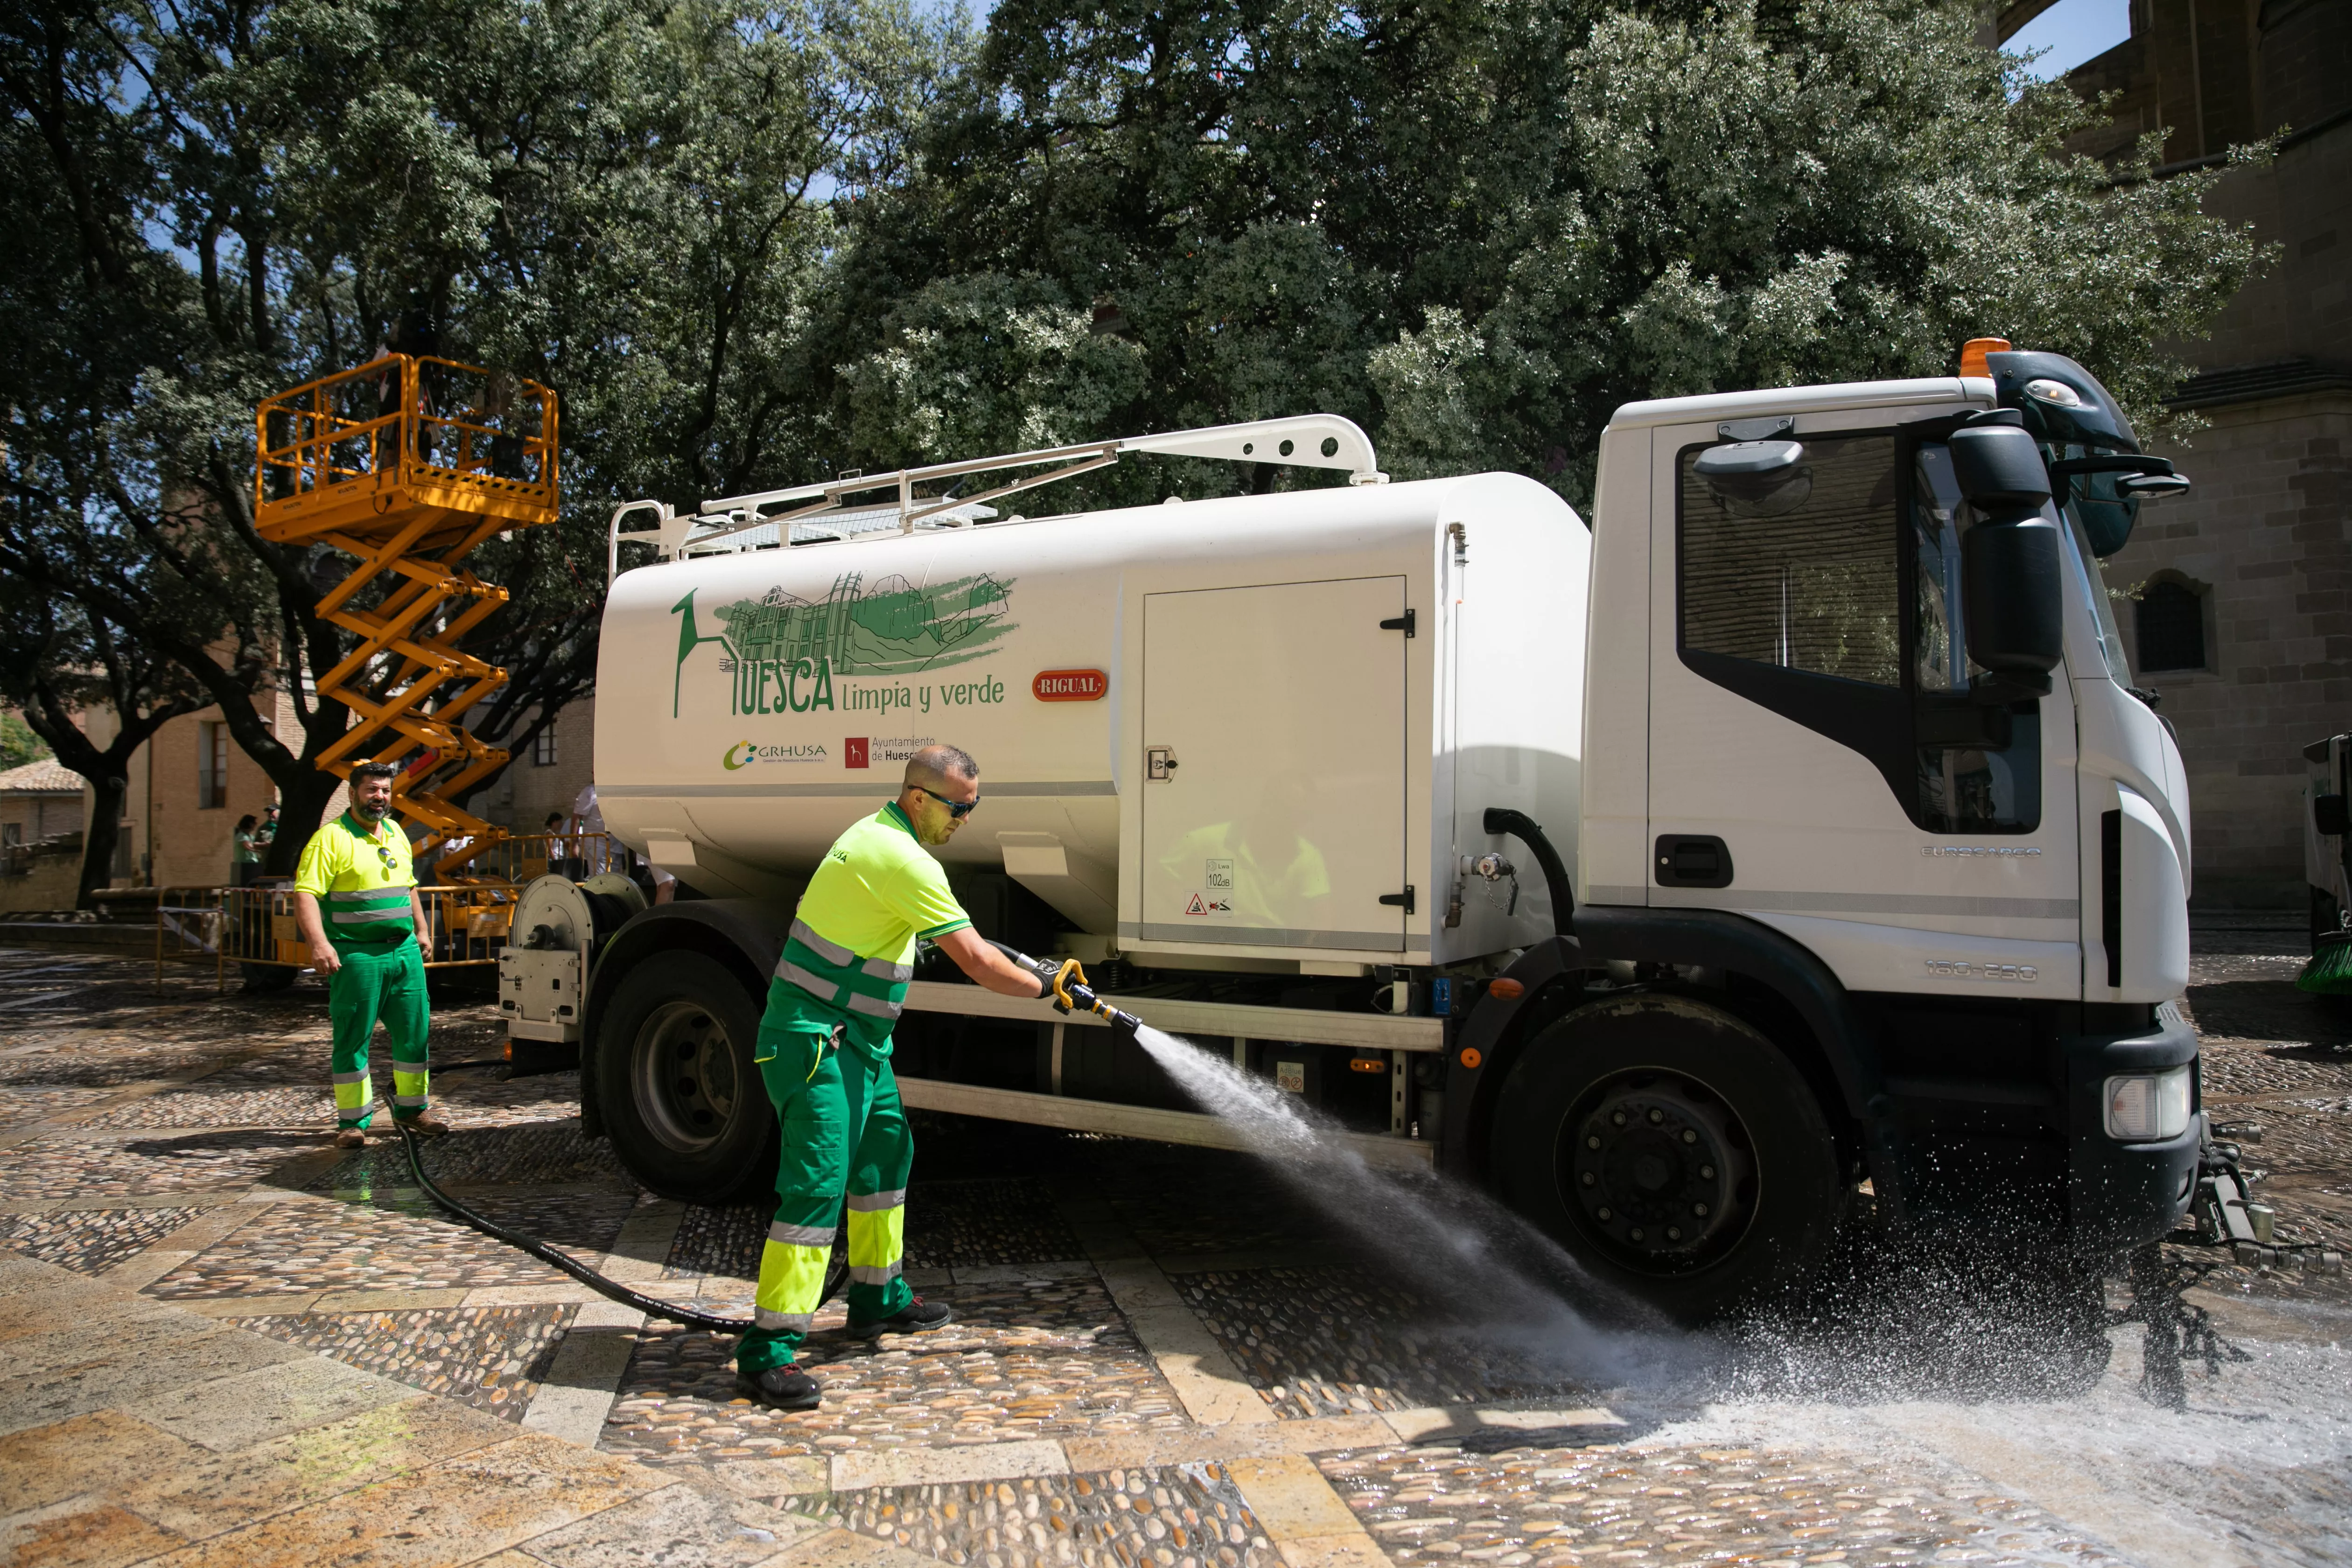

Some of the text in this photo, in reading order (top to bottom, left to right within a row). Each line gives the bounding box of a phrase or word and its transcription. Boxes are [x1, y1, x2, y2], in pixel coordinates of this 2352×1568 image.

[1040, 678, 1097, 693] RIGUAL
[919, 686, 931, 713] y
[940, 674, 1004, 706] verde
[872, 736, 935, 750] Ayuntamiento
[758, 745, 827, 757] GRHUSA
[872, 750, 917, 761] de Huesc
[1920, 846, 2042, 858] EUROCARGO
[1925, 959, 2037, 981] 180-250
